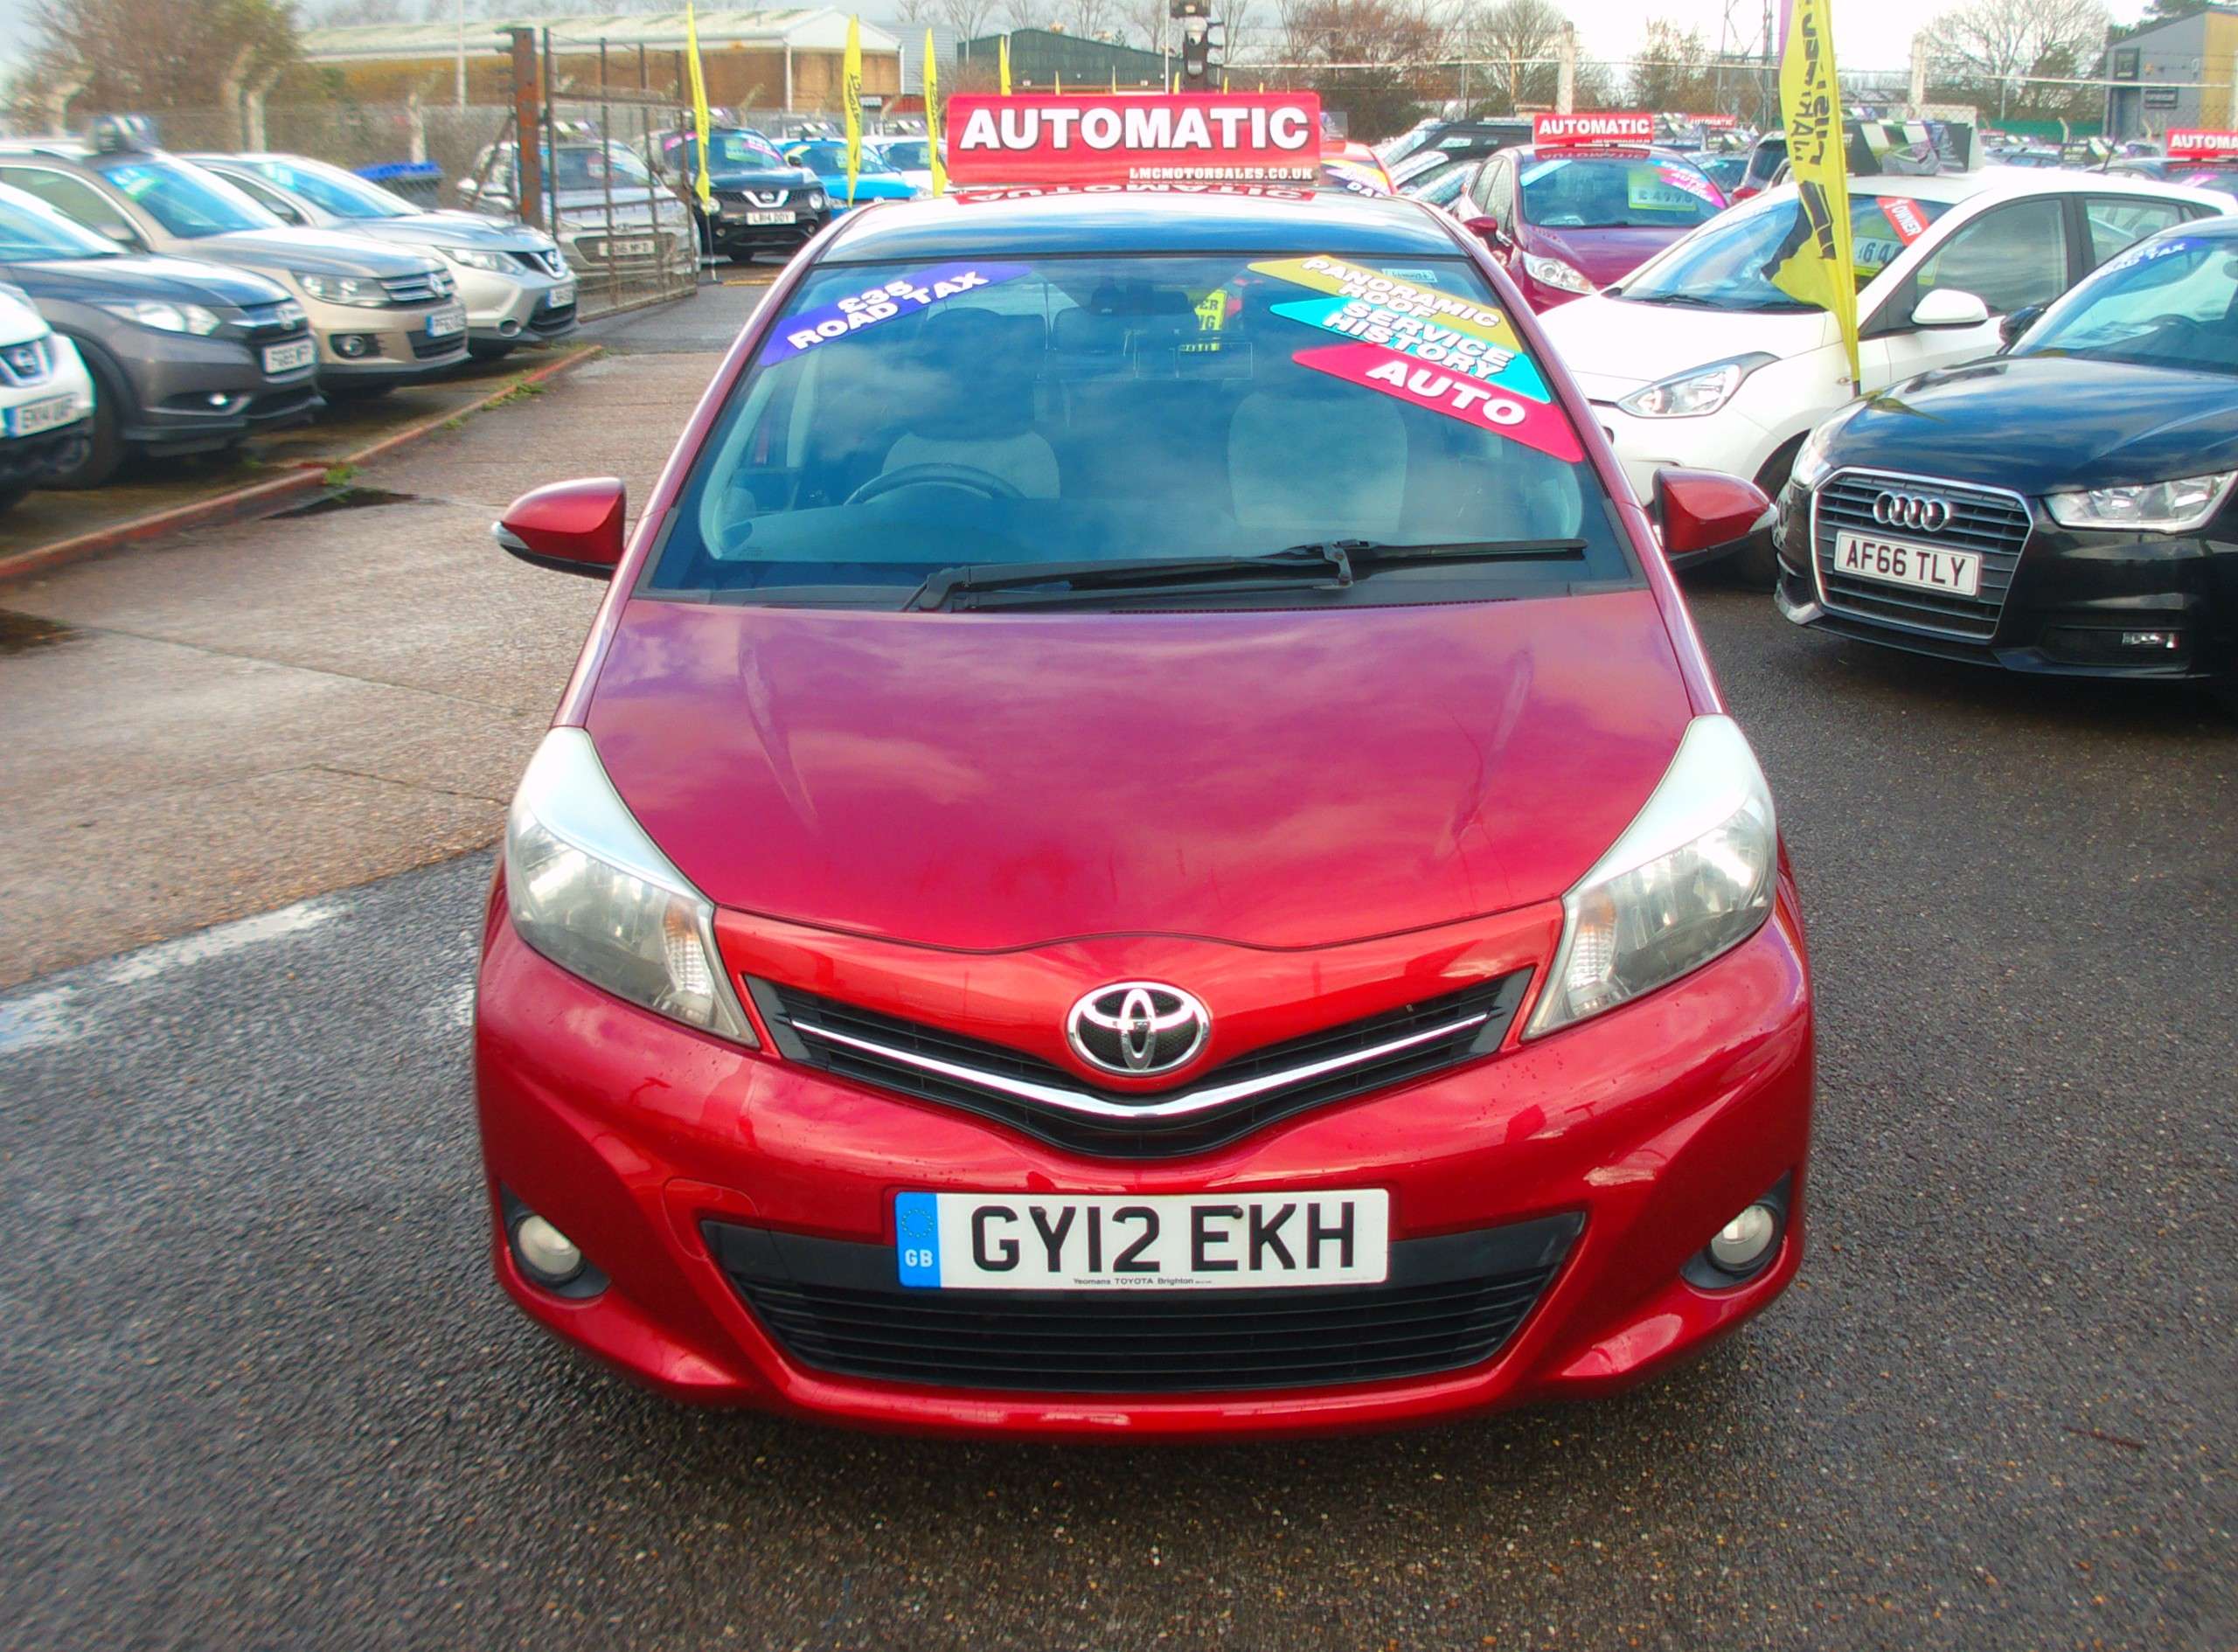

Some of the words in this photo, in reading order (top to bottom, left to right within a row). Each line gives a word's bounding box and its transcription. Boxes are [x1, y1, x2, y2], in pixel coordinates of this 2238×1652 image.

[959, 107, 1310, 150] AUTOMATIC
[1539, 119, 1651, 135] AUTOMATIC
[787, 302, 900, 351] ROAD
[902, 271, 990, 304] TAX
[837, 281, 914, 313] £35
[1301, 259, 1500, 329] PANORAMIC
[1338, 281, 1440, 320] ROOF
[1322, 312, 1508, 380] HISTORY
[1341, 302, 1516, 368] SERVICE
[1365, 359, 1526, 426] AUTO
[1846, 540, 1907, 576] AF66
[1916, 552, 1965, 587] TLY
[904, 1249, 933, 1267] GB
[970, 1204, 1161, 1273] GY12
[1190, 1201, 1356, 1272] EKH
[1157, 1277, 1194, 1287] Brighton
